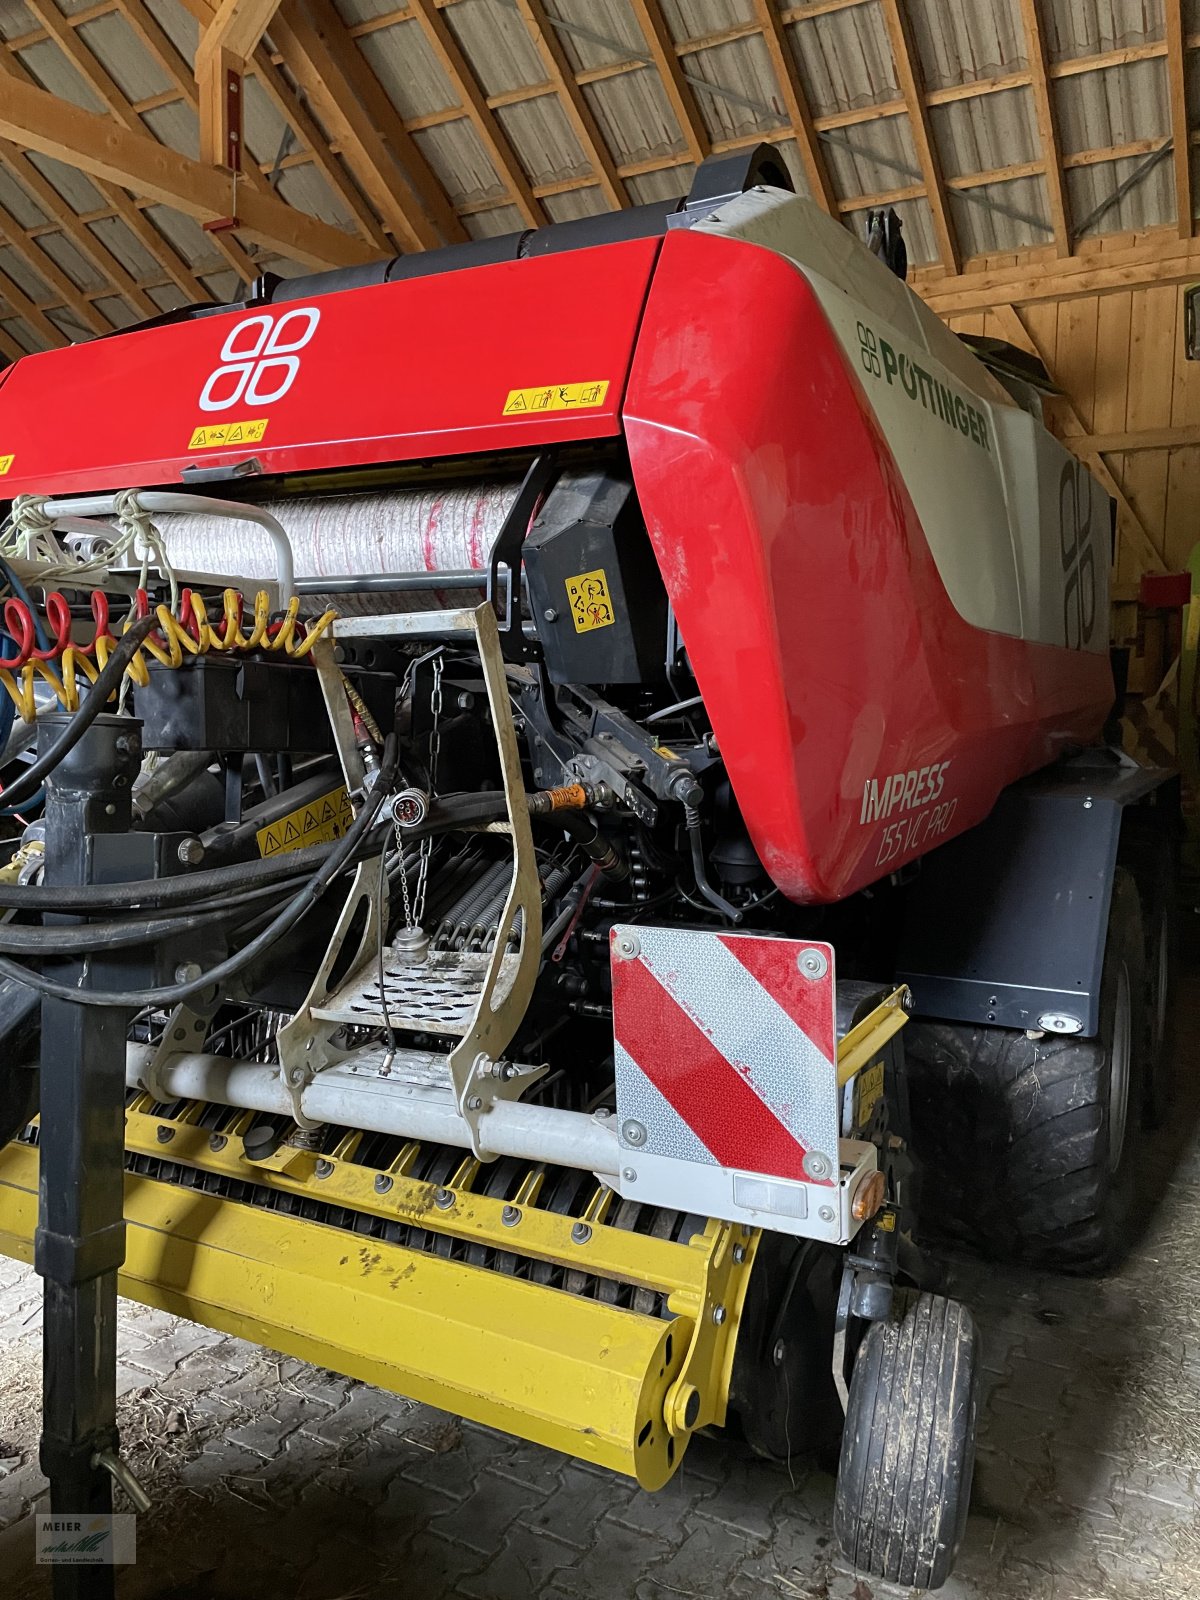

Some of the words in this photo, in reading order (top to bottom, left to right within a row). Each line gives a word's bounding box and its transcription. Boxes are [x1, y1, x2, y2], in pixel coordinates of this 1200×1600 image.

[860, 760, 951, 825] IMPRESS
[875, 820, 907, 867] 155
[903, 810, 929, 853] VC
[923, 798, 958, 842] PRO
